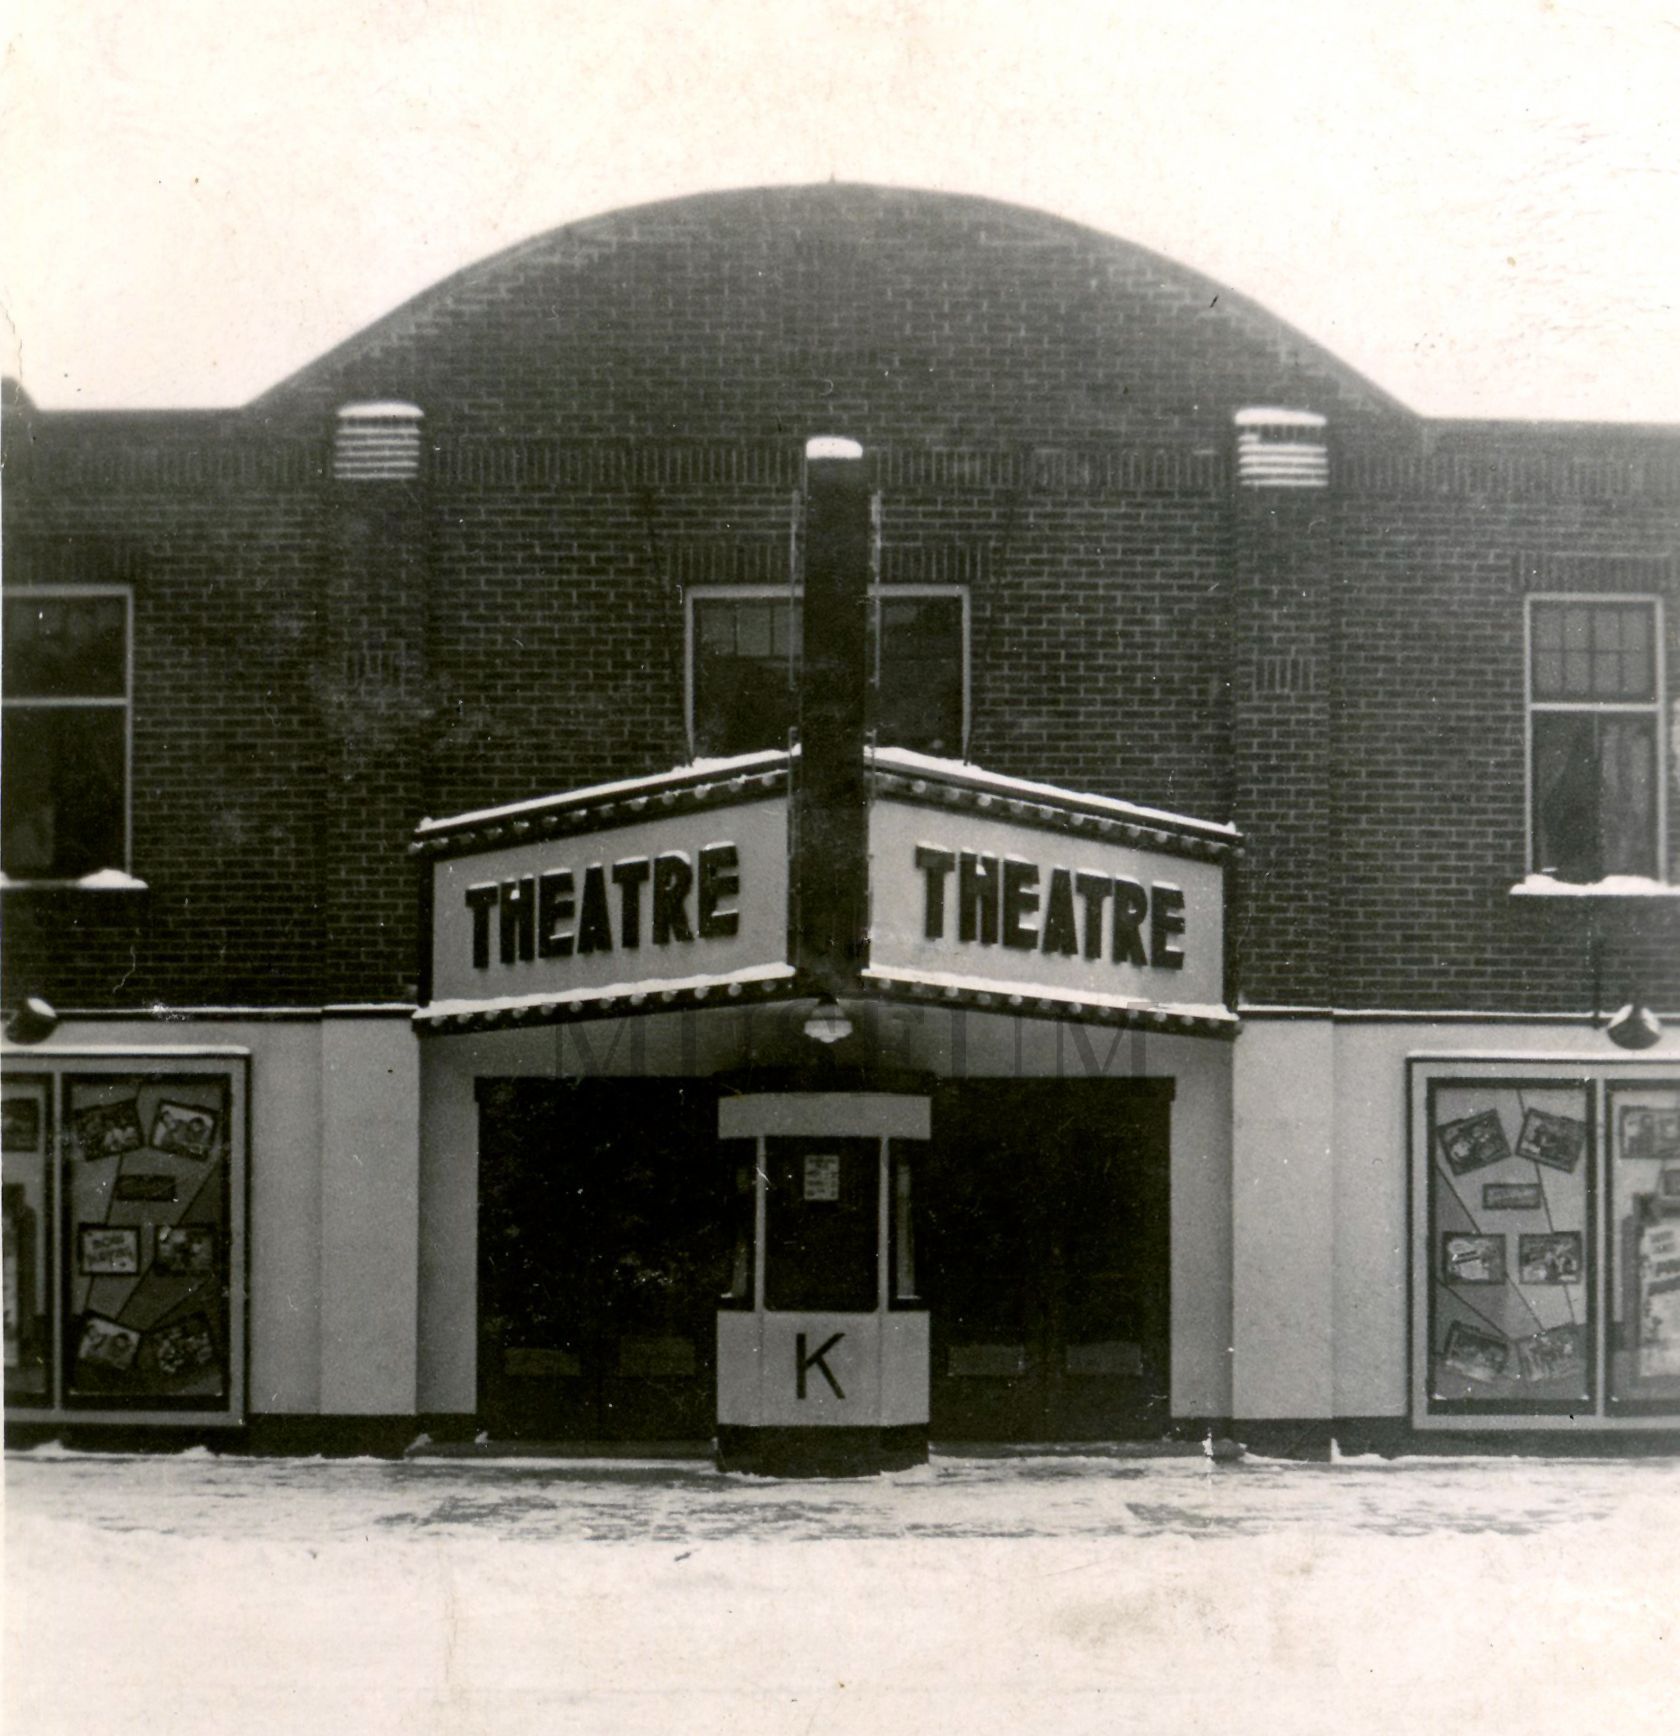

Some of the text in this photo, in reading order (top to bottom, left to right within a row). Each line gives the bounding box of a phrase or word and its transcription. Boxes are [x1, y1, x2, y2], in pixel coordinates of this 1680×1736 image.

[464, 842, 740, 970] THEATRE
[914, 841, 1186, 970] THEATRE
[796, 1332, 846, 1400] K
